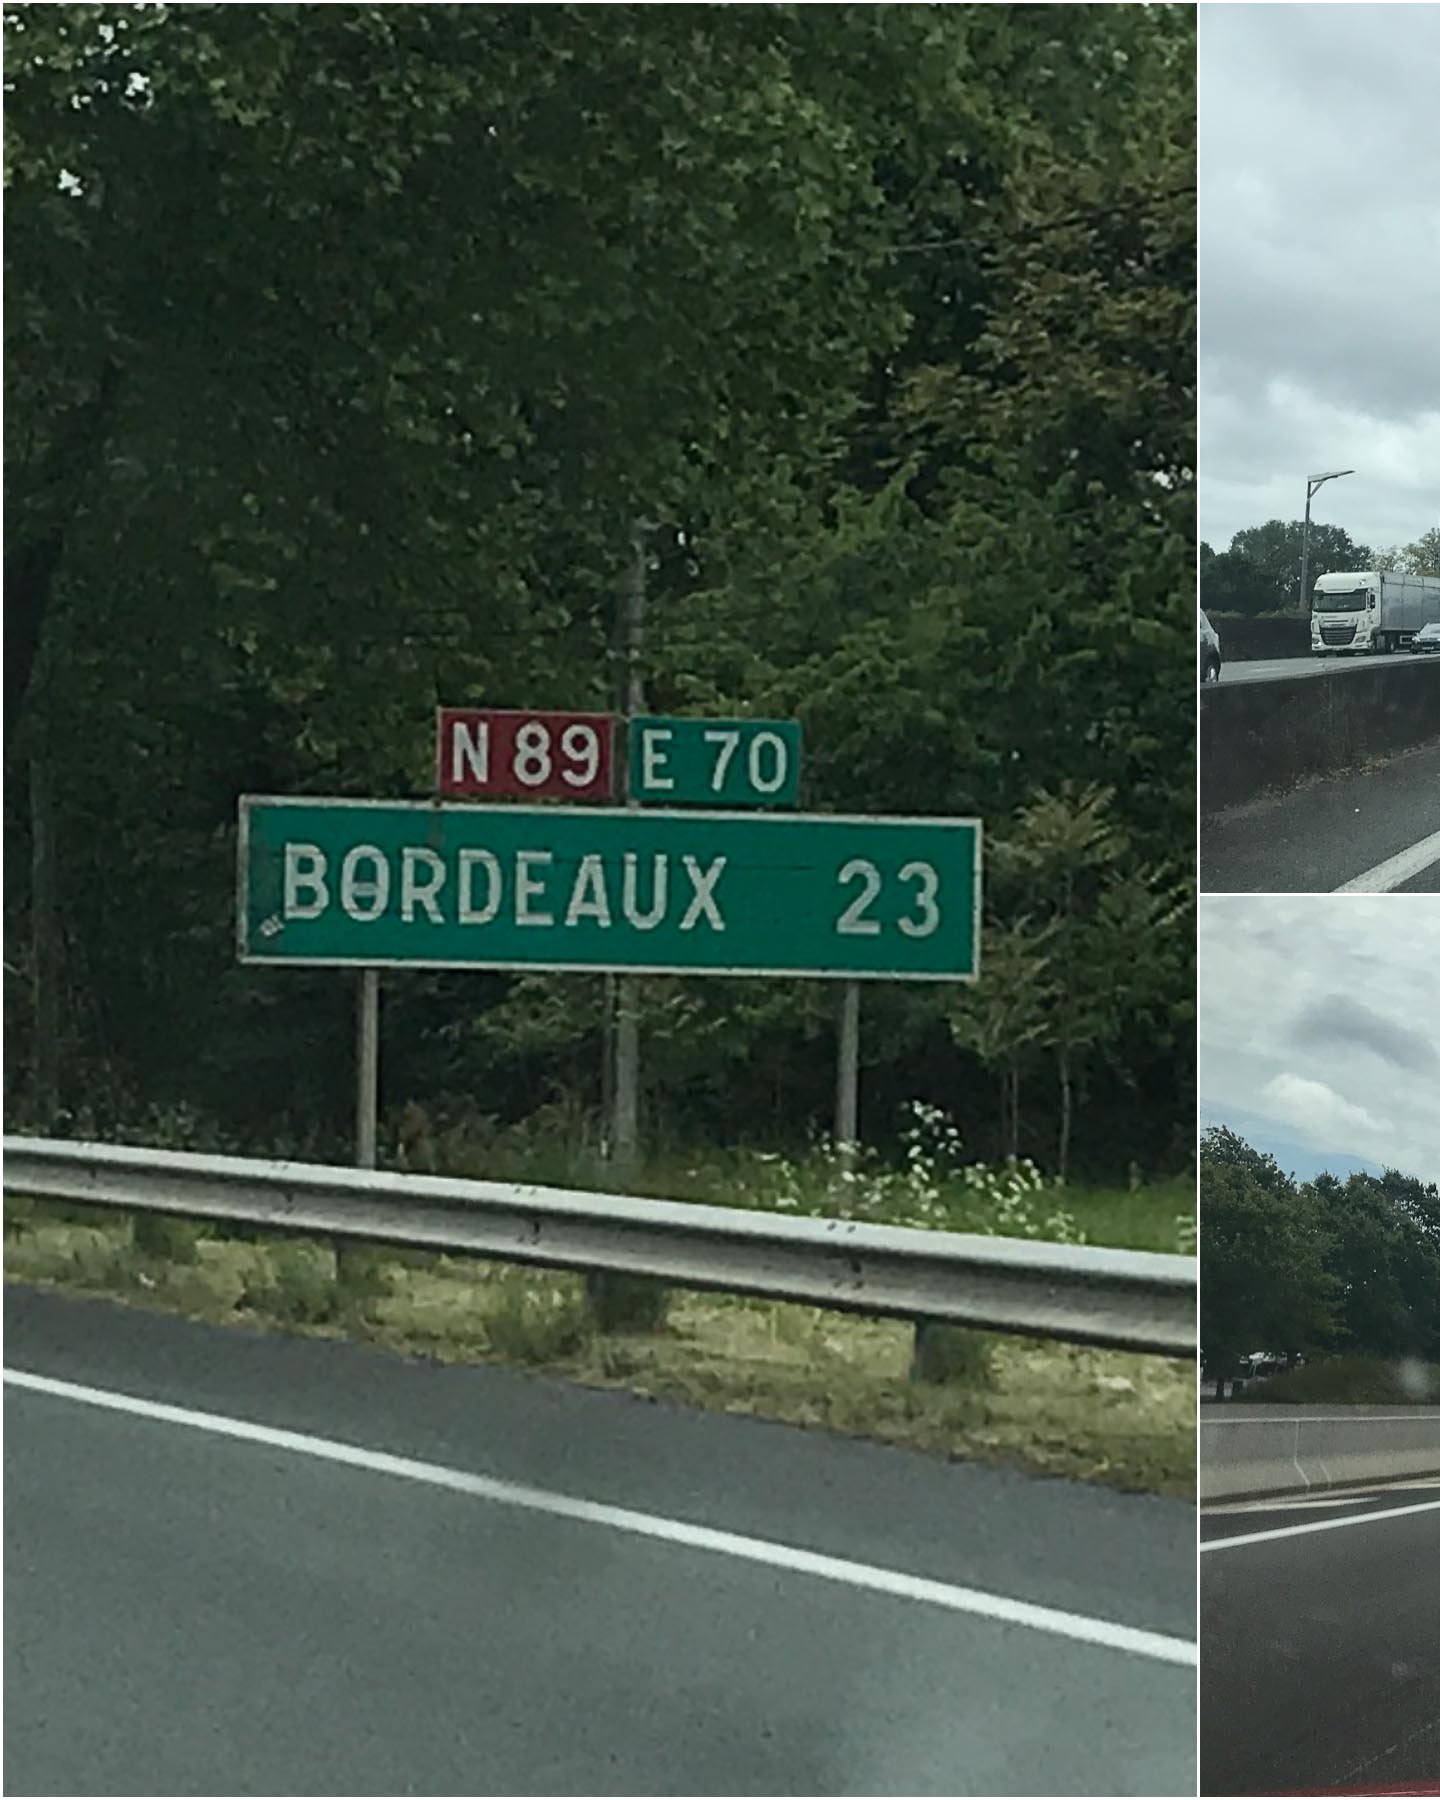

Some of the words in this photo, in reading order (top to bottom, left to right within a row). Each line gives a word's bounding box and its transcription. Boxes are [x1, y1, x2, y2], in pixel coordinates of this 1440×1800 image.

[451, 720, 489, 784] N
[513, 721, 601, 787] 89
[642, 728, 675, 791] E
[704, 730, 790, 794] 70
[284, 841, 728, 932] BORDEAUX
[836, 858, 942, 938] 23
